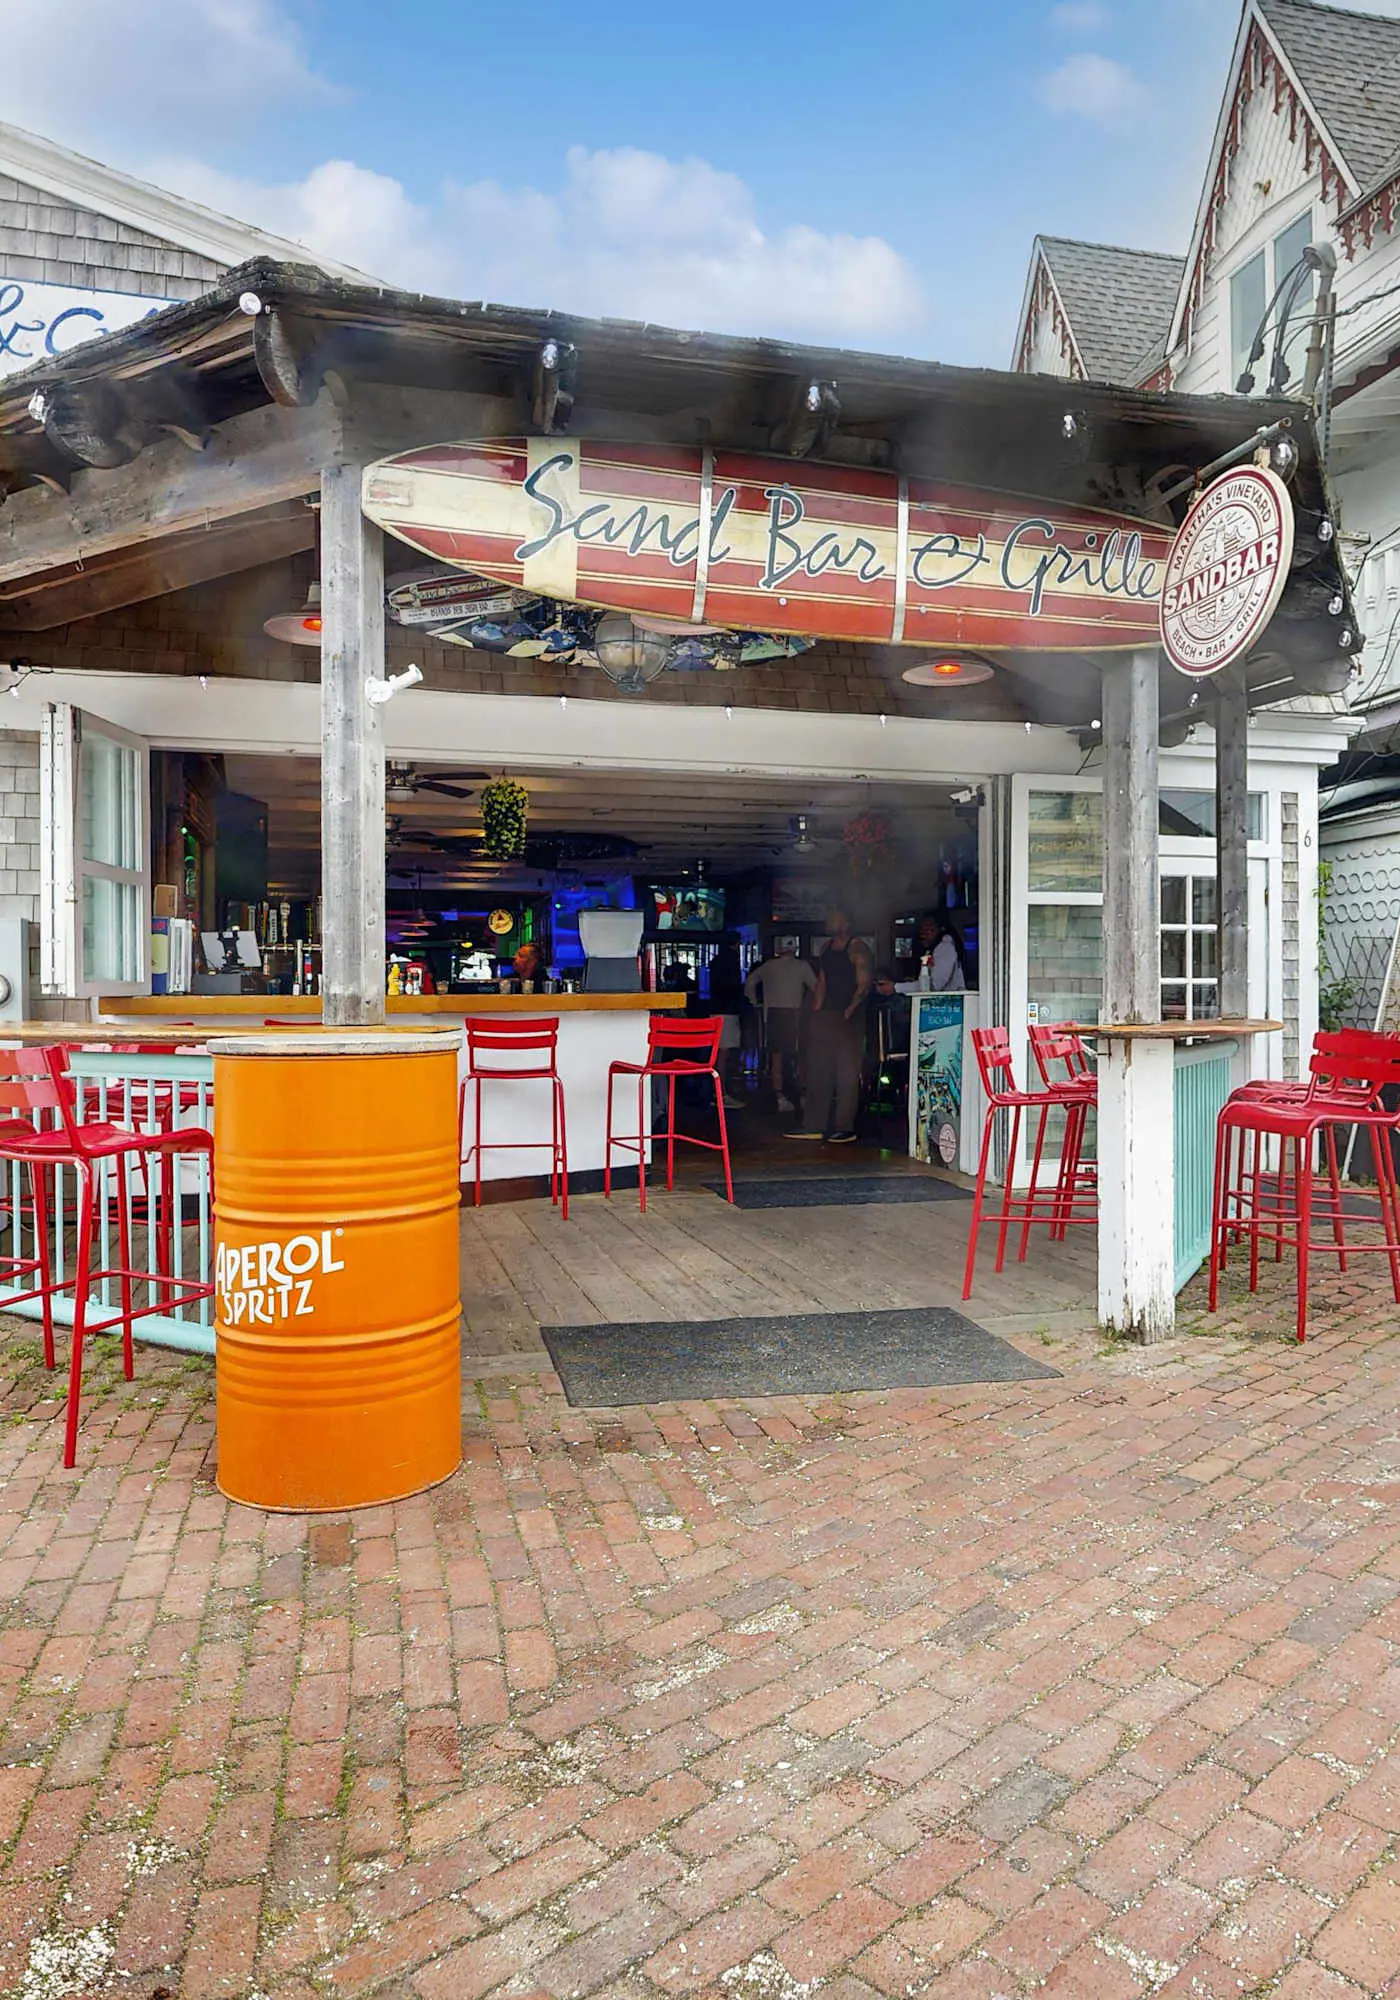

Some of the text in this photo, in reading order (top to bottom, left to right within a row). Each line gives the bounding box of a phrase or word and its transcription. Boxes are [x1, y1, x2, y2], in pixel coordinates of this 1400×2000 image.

[515, 454, 1161, 617] Sand Bar & Grille
[1174, 483, 1271, 571] MARTHA'S VINEYARD
[1163, 533, 1280, 614] SANDBAR
[1172, 588, 1264, 658] BEACH BAR GRILL
[1304, 829, 1311, 847] 6
[215, 1229, 345, 1296] APEROL
